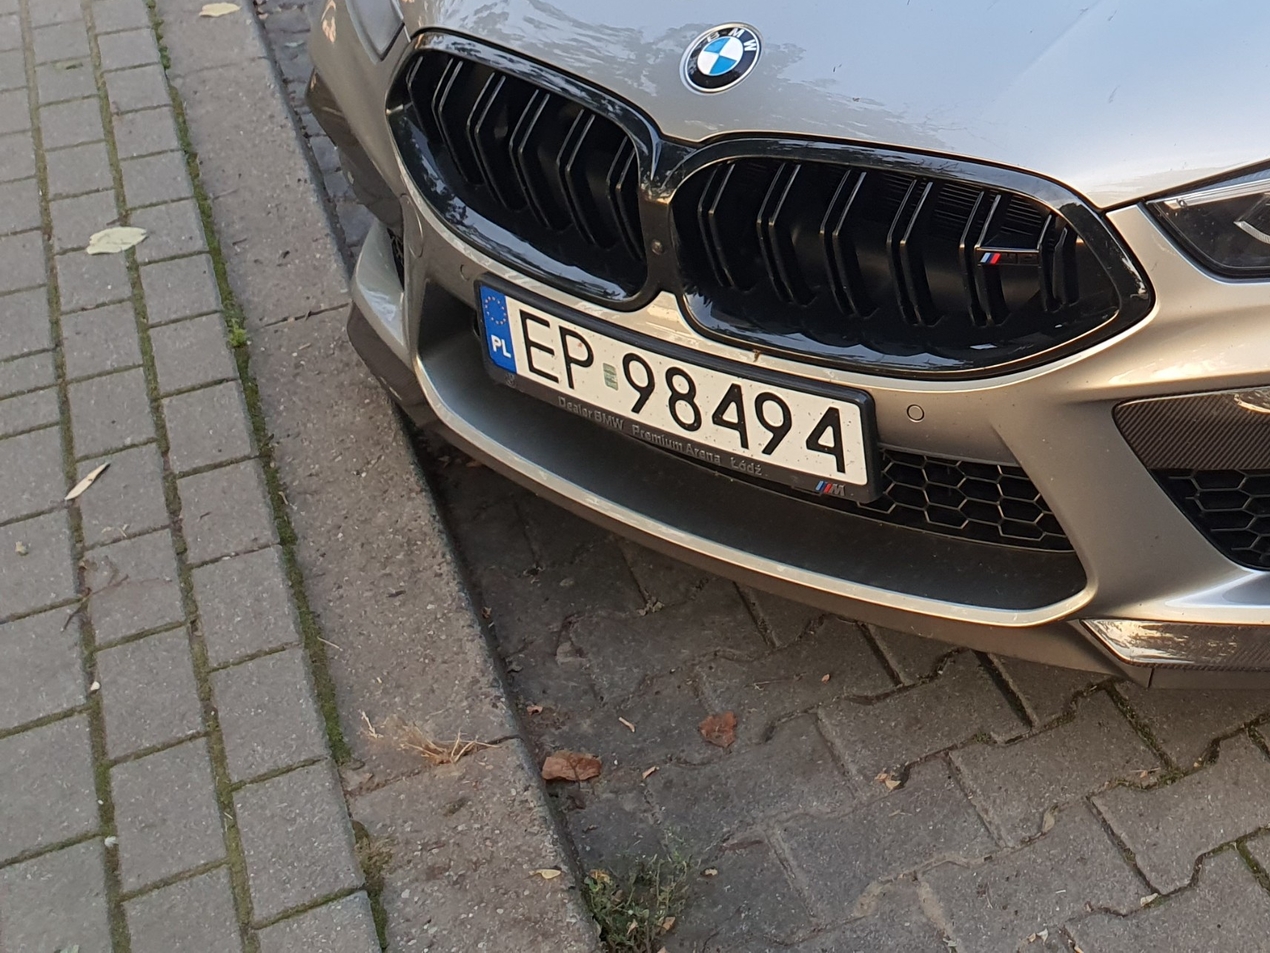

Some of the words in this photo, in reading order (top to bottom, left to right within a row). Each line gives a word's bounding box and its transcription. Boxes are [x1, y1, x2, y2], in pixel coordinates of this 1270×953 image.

[490, 334, 512, 358] PL
[518, 308, 595, 390] EP
[622, 352, 846, 474] 98494
[558, 395, 592, 418] Dealer
[594, 410, 624, 431] BMW
[631, 423, 683, 452] Premium
[685, 442, 721, 467] Arena
